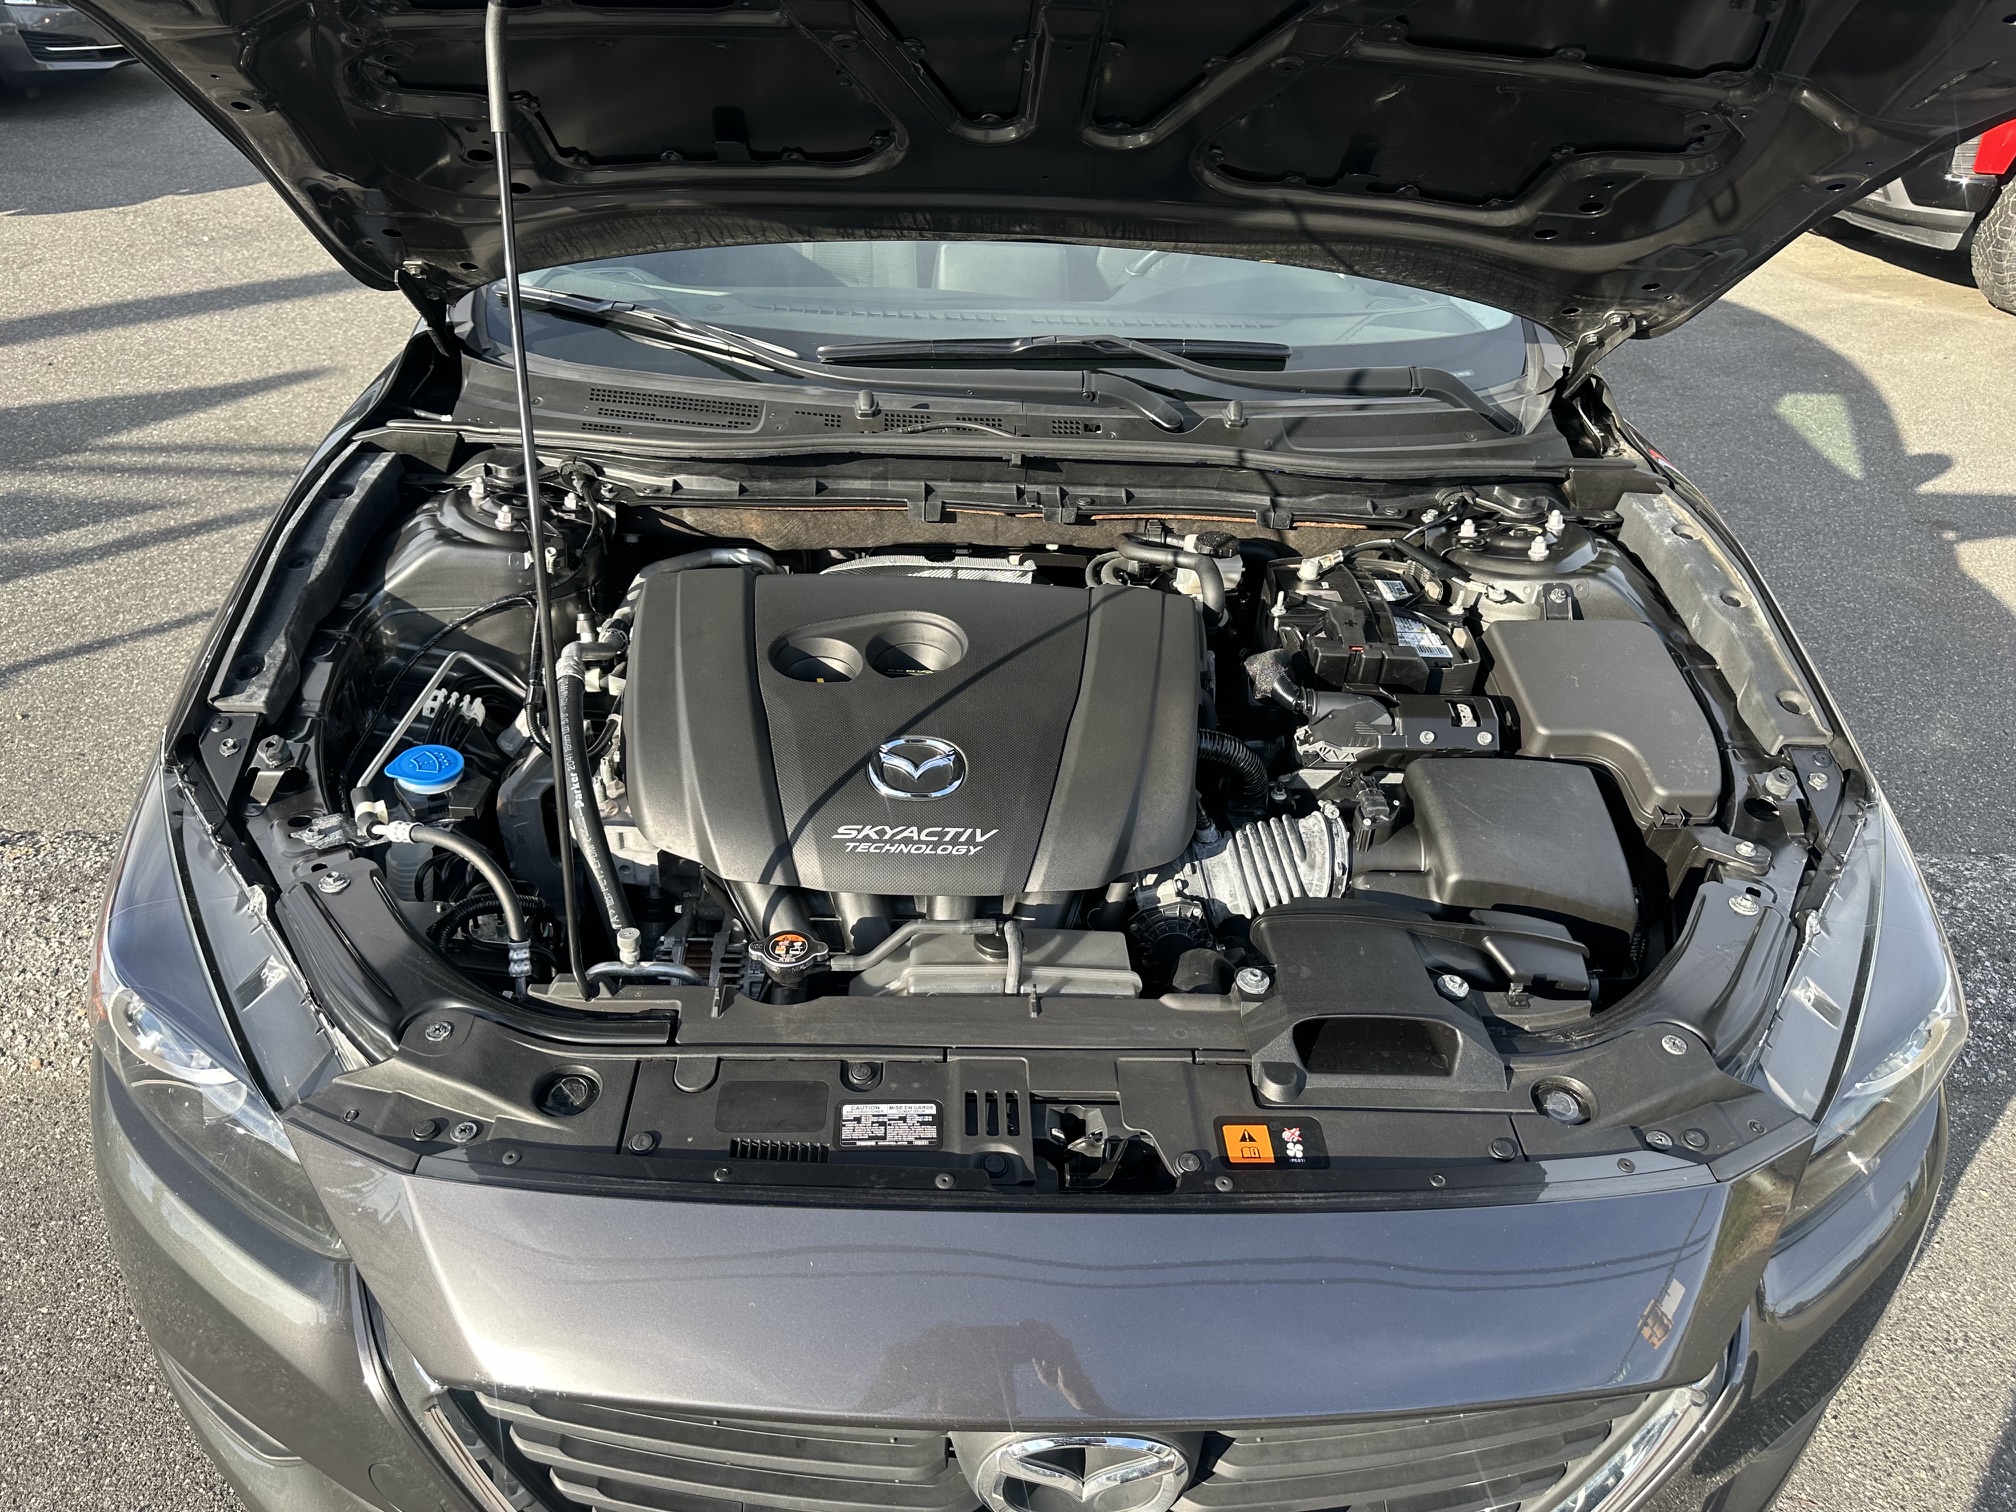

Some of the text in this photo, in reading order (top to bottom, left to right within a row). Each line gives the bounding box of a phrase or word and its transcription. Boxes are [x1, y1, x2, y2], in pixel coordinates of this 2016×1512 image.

[570, 772, 584, 808] Parker
[831, 825, 999, 856] SKYACTIV TECHNOLOGY
